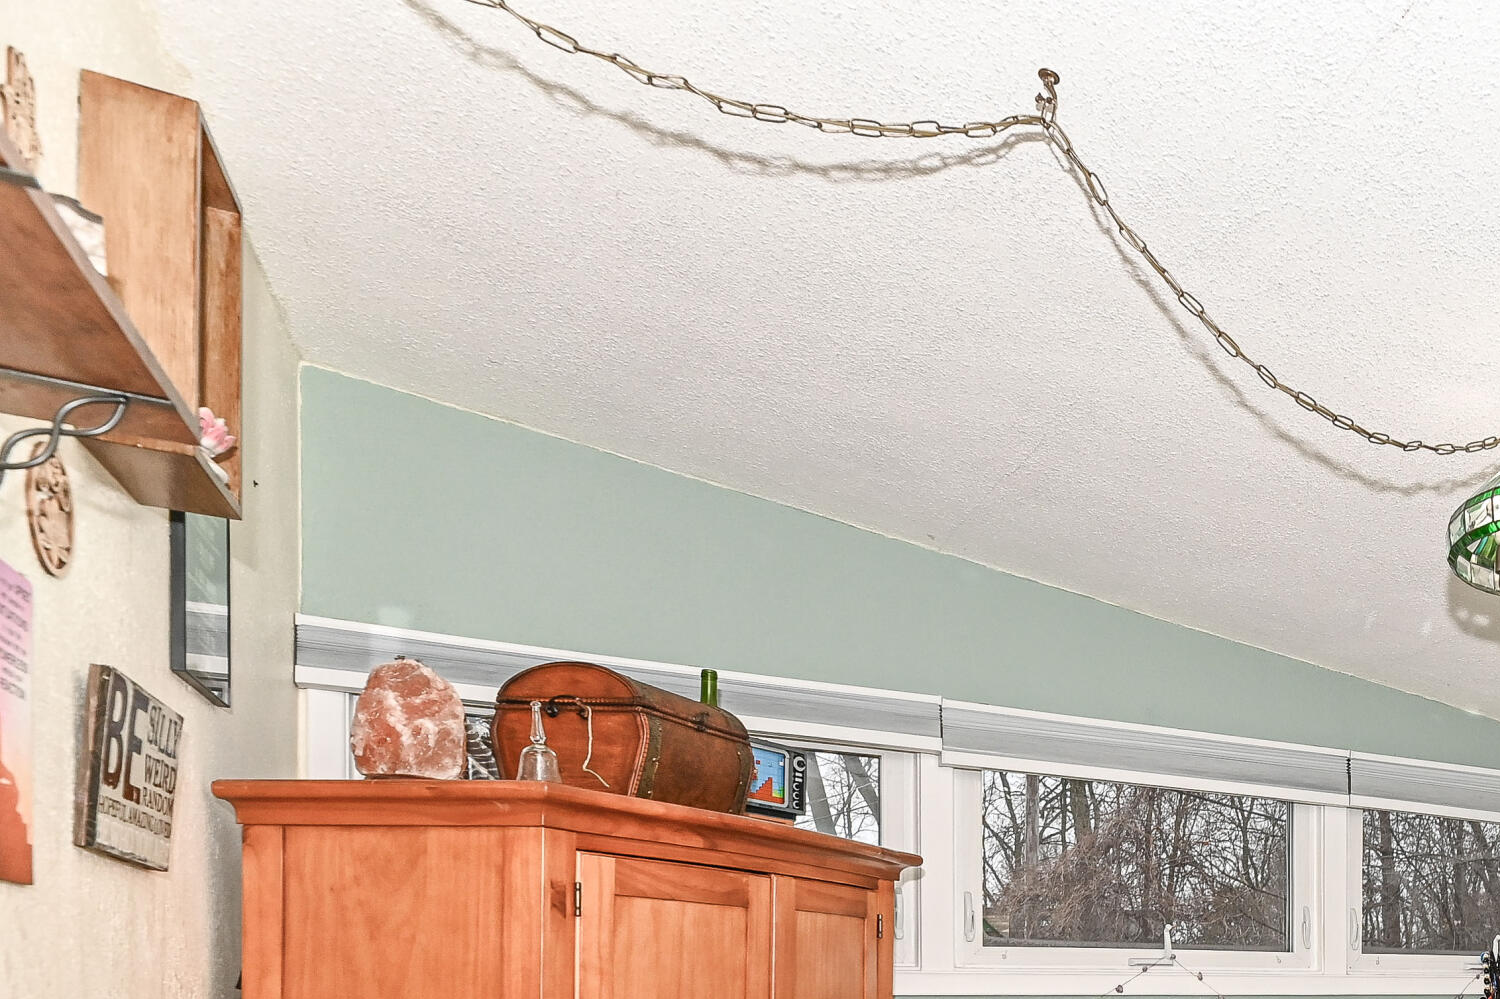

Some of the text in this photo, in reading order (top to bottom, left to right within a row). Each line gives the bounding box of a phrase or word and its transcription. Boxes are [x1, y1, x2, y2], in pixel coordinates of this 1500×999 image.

[103, 673, 149, 804] BE
[148, 705, 179, 759] SILLY
[144, 753, 176, 794] WEIRD
[141, 786, 174, 817] RANDOM
